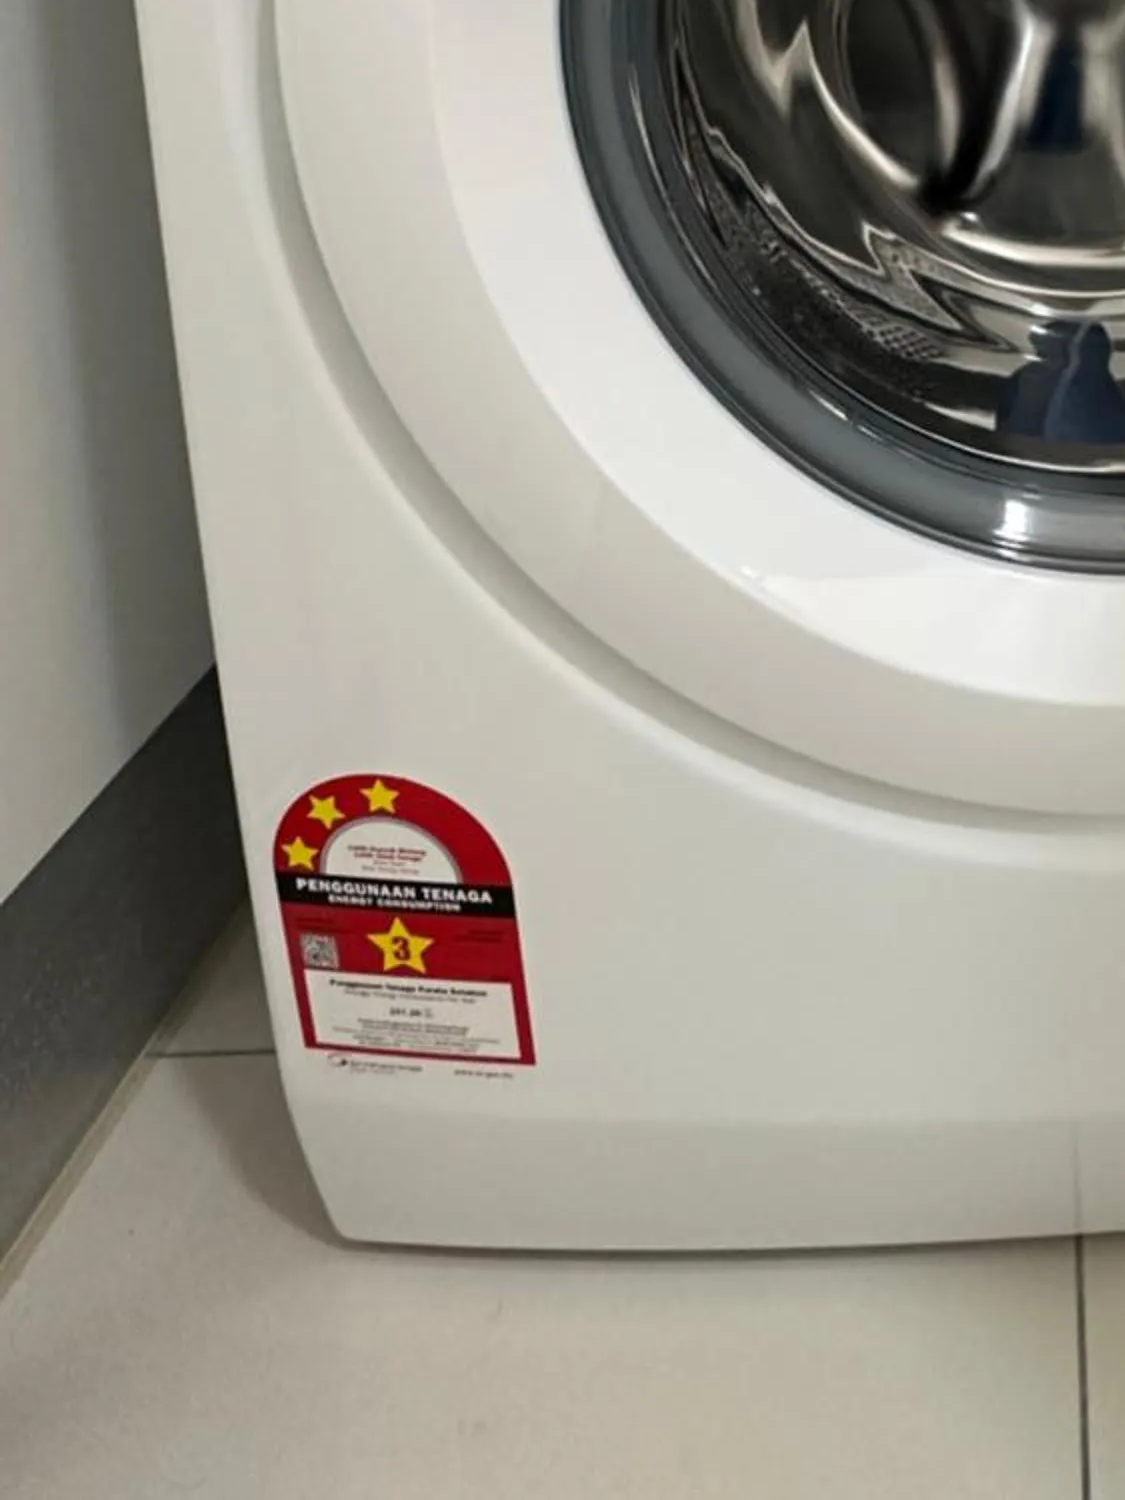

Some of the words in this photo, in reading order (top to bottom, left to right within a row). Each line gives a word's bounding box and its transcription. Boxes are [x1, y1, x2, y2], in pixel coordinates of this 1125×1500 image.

[295, 877, 417, 900] PENGGUNAAN
[421, 887, 493, 904] TENAGA
[328, 894, 374, 907] ENERGY
[376, 897, 462, 913] CONSUMPTION
[390, 935, 411, 962] 3
